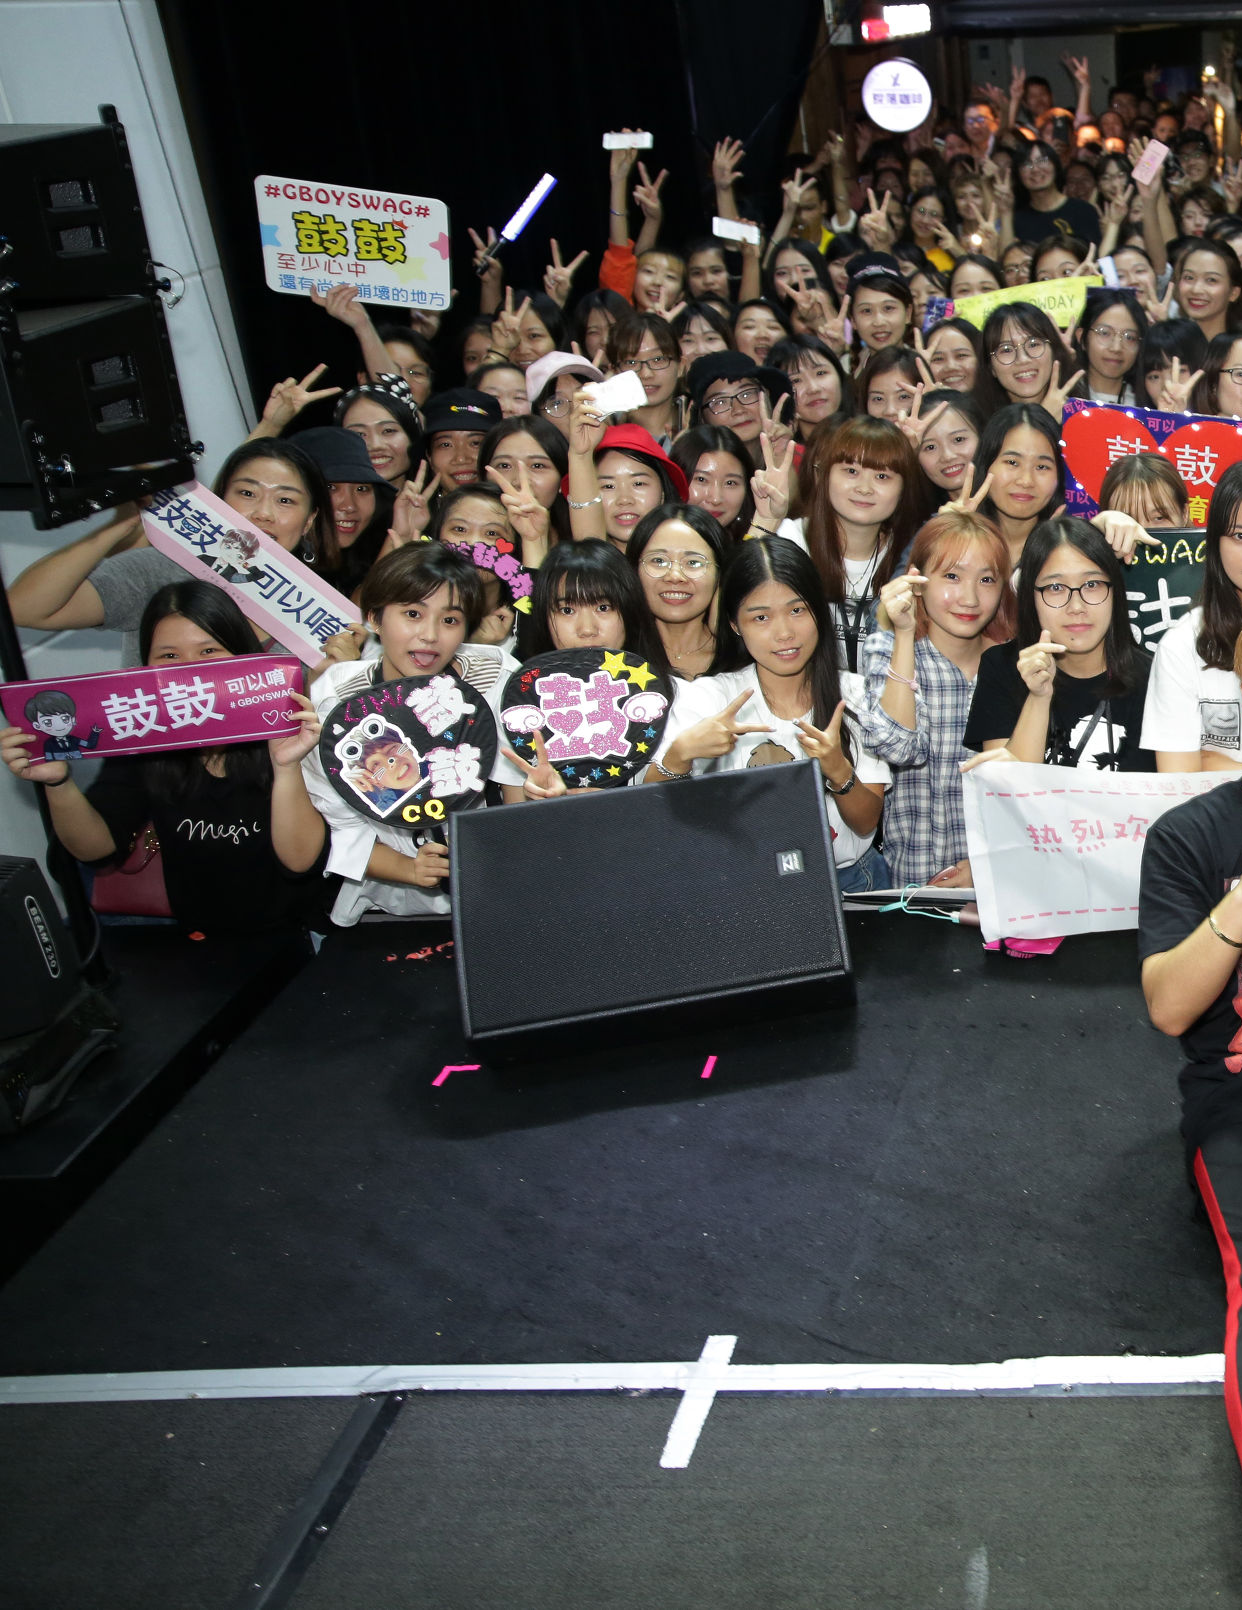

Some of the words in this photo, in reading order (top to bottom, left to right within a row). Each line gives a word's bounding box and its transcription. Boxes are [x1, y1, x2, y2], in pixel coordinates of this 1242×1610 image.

[292, 211, 408, 265] 鼓鼓
[276, 252, 367, 278] 至少心中
[278, 273, 446, 307] 還有尚崩壞的地方
[1146, 416, 1176, 433] 可以
[1064, 489, 1091, 506] 可以
[225, 668, 287, 695] 可以唷
[101, 675, 225, 741] 鼓鼓
[402, 799, 446, 823] CQ
[29, 907, 49, 943] BEAM
[45, 944, 57, 968] 230
